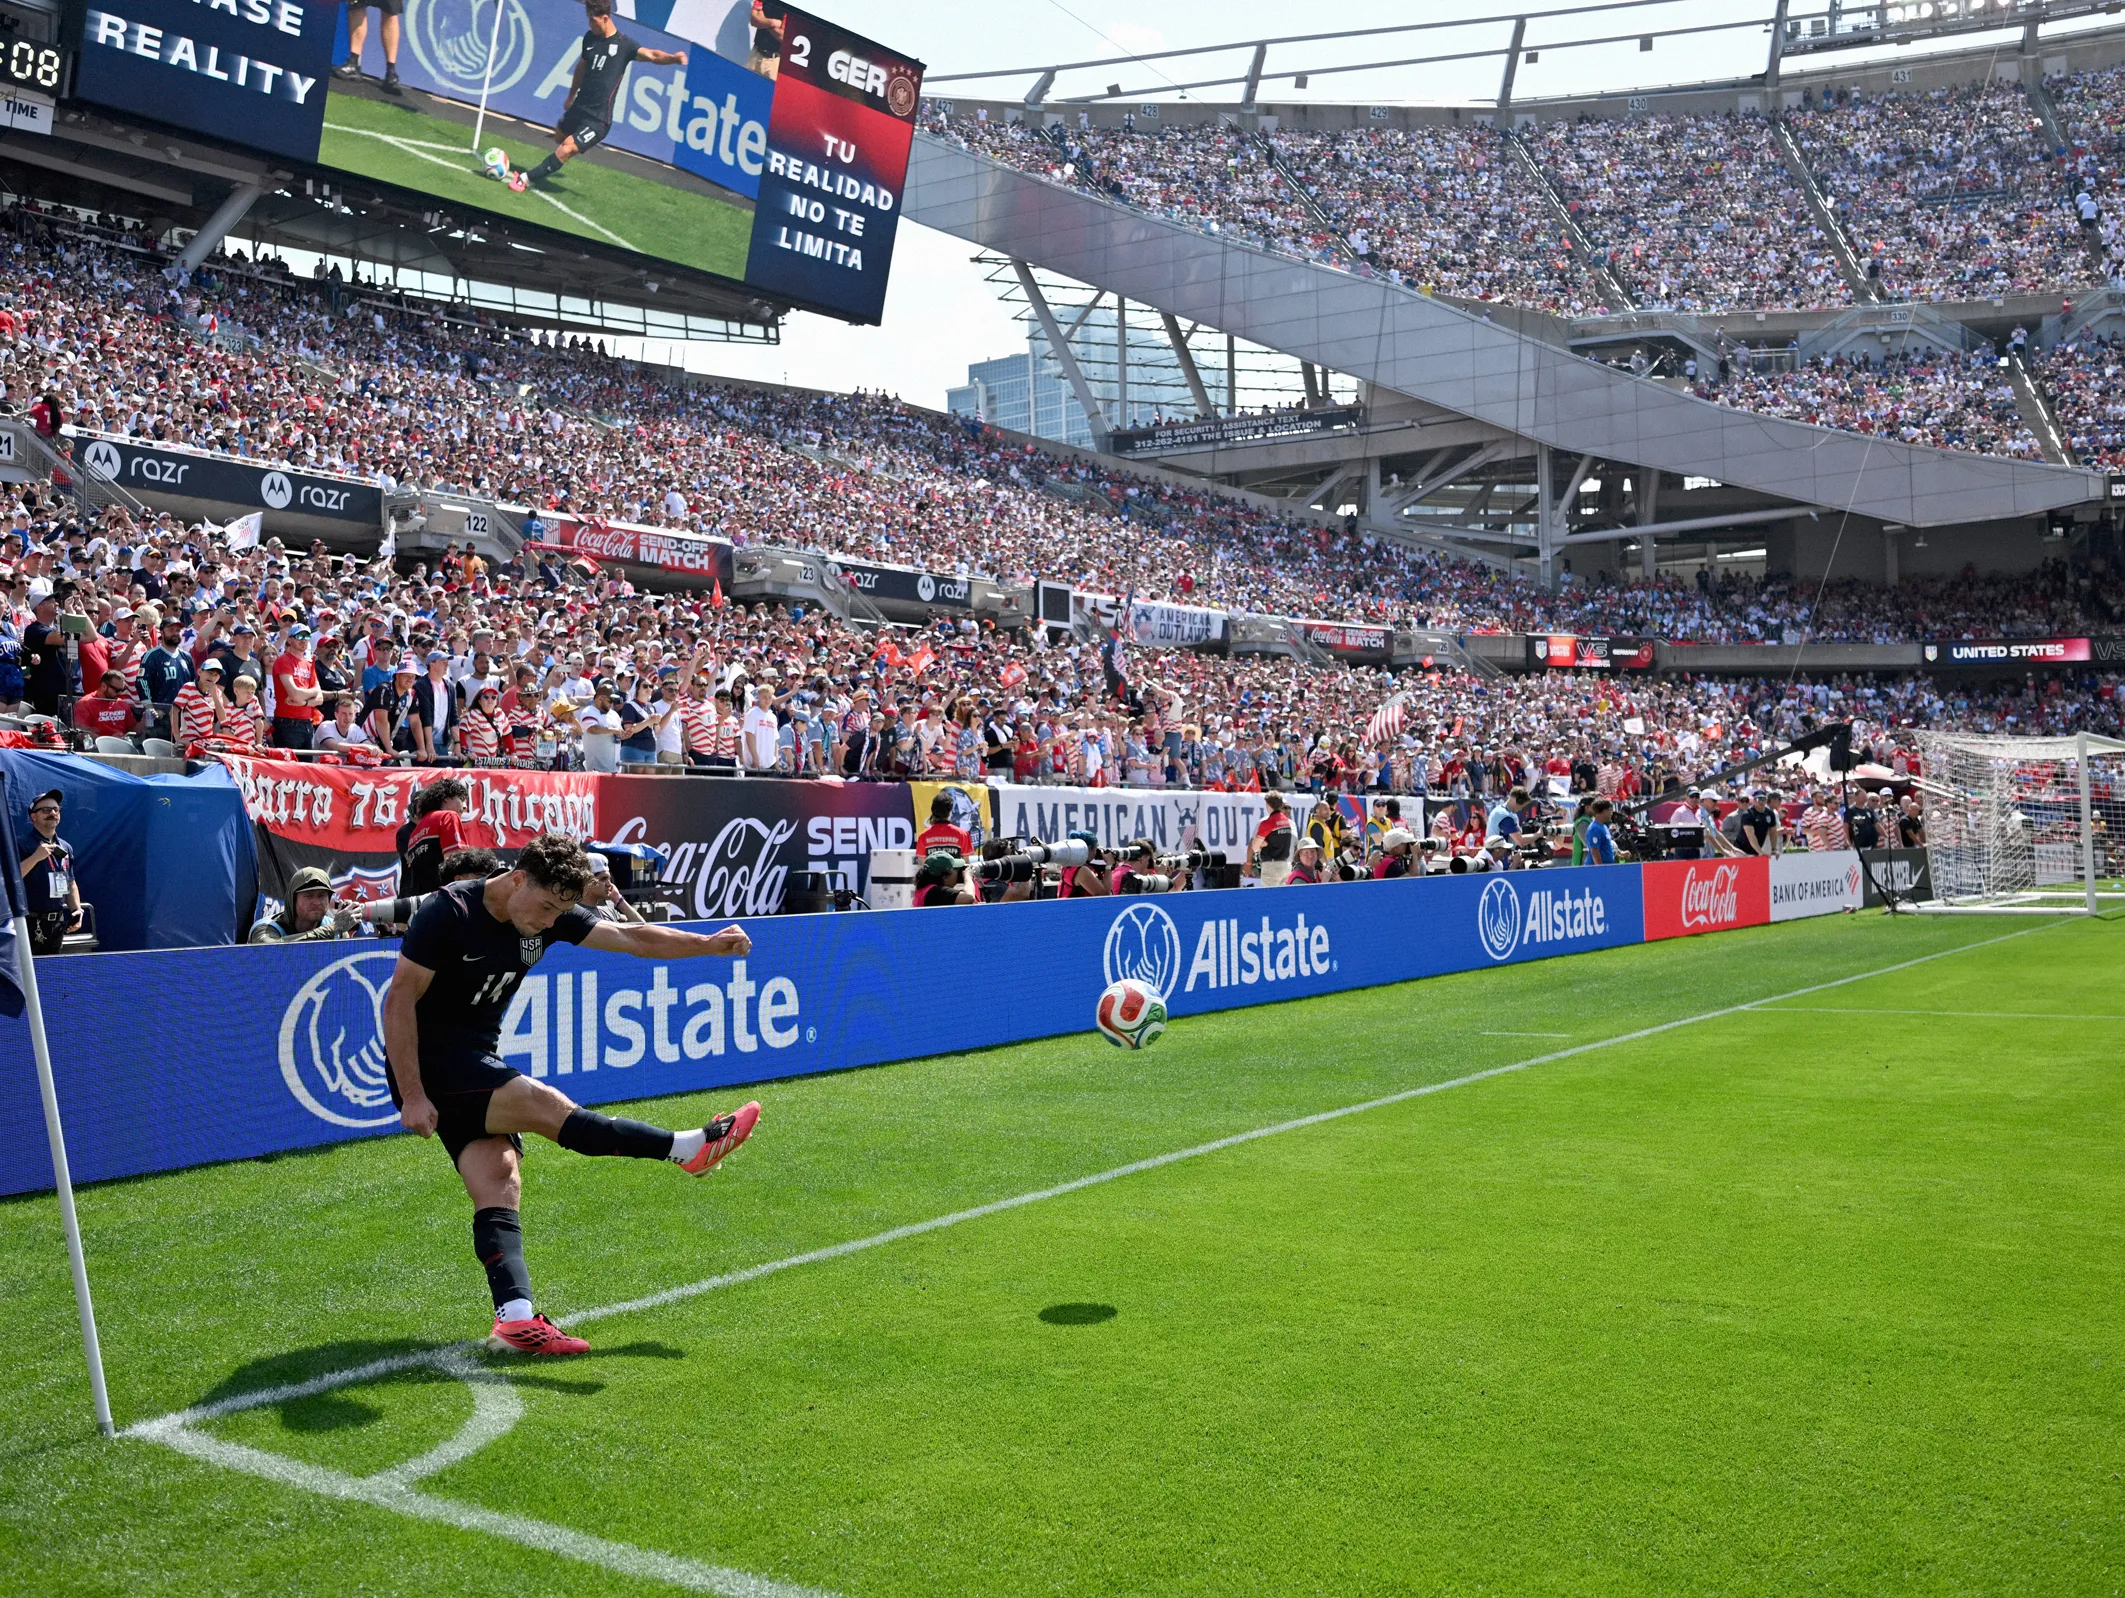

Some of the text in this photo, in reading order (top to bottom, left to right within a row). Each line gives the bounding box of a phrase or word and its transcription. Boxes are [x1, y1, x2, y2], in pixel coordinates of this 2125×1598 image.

[192, 0, 304, 37] ASE
[97, 11, 316, 105] REALITY
[591, 53, 607, 71] 14
[789, 35, 812, 68] 2
[827, 50, 888, 98] GER
[1893, 70, 1912, 82] 431
[5, 99, 38, 119] TIME
[533, 36, 767, 177] Alstate
[1141, 105, 1158, 118] 428
[1371, 106, 1389, 119] 429
[1628, 98, 1647, 110] 430
[824, 134, 856, 163] TU
[769, 155, 894, 212] REALIDAD
[790, 195, 865, 238] NO TE
[778, 236, 863, 271] LIMITA
[1891, 311, 1909, 323] 330
[1134, 419, 1322, 449] 312-262-4151 THE ISSUE & LOCATION
[1155, 429, 1173, 439] FOR
[1174, 425, 1216, 437] SECURITY
[1222, 417, 1276, 431] ASSISTANCE
[1277, 414, 1300, 425] TEXT
[131, 456, 189, 485] razr
[300, 484, 350, 511] razr
[465, 513, 488, 533] 122
[573, 524, 637, 559] Coca-Cola
[639, 533, 709, 552] SEND-OFF
[639, 547, 709, 570] MATCH
[939, 583, 968, 600] razr
[1160, 609, 1211, 628] AMERICAN
[1159, 624, 1211, 642] OUTLAWS
[1311, 627, 1343, 645] Coca-Cola
[1345, 629, 1385, 639] SEND-OFF
[1345, 637, 1385, 649] MATCH
[1576, 641, 1608, 658] VS
[1612, 648, 1639, 656] GERMANY
[1952, 646, 2008, 660] UNITED
[2009, 643, 2065, 658] STATES
[163, 666, 177, 680] 10
[474, 756, 506, 766] ESTADOS
[350, 780, 400, 828] 76
[1014, 801, 1168, 849] AMERICAN
[1870, 861, 1887, 895] NIKE
[1681, 864, 1739, 928] Coca-Cola
[1773, 878, 1845, 905] BANK OF AMERICA
[1523, 886, 1605, 945] Allstate
[521, 938, 541, 951] USA
[1184, 912, 1332, 993] Allstate
[471, 971, 517, 1006] 14
[496, 959, 801, 1078] Allstate
